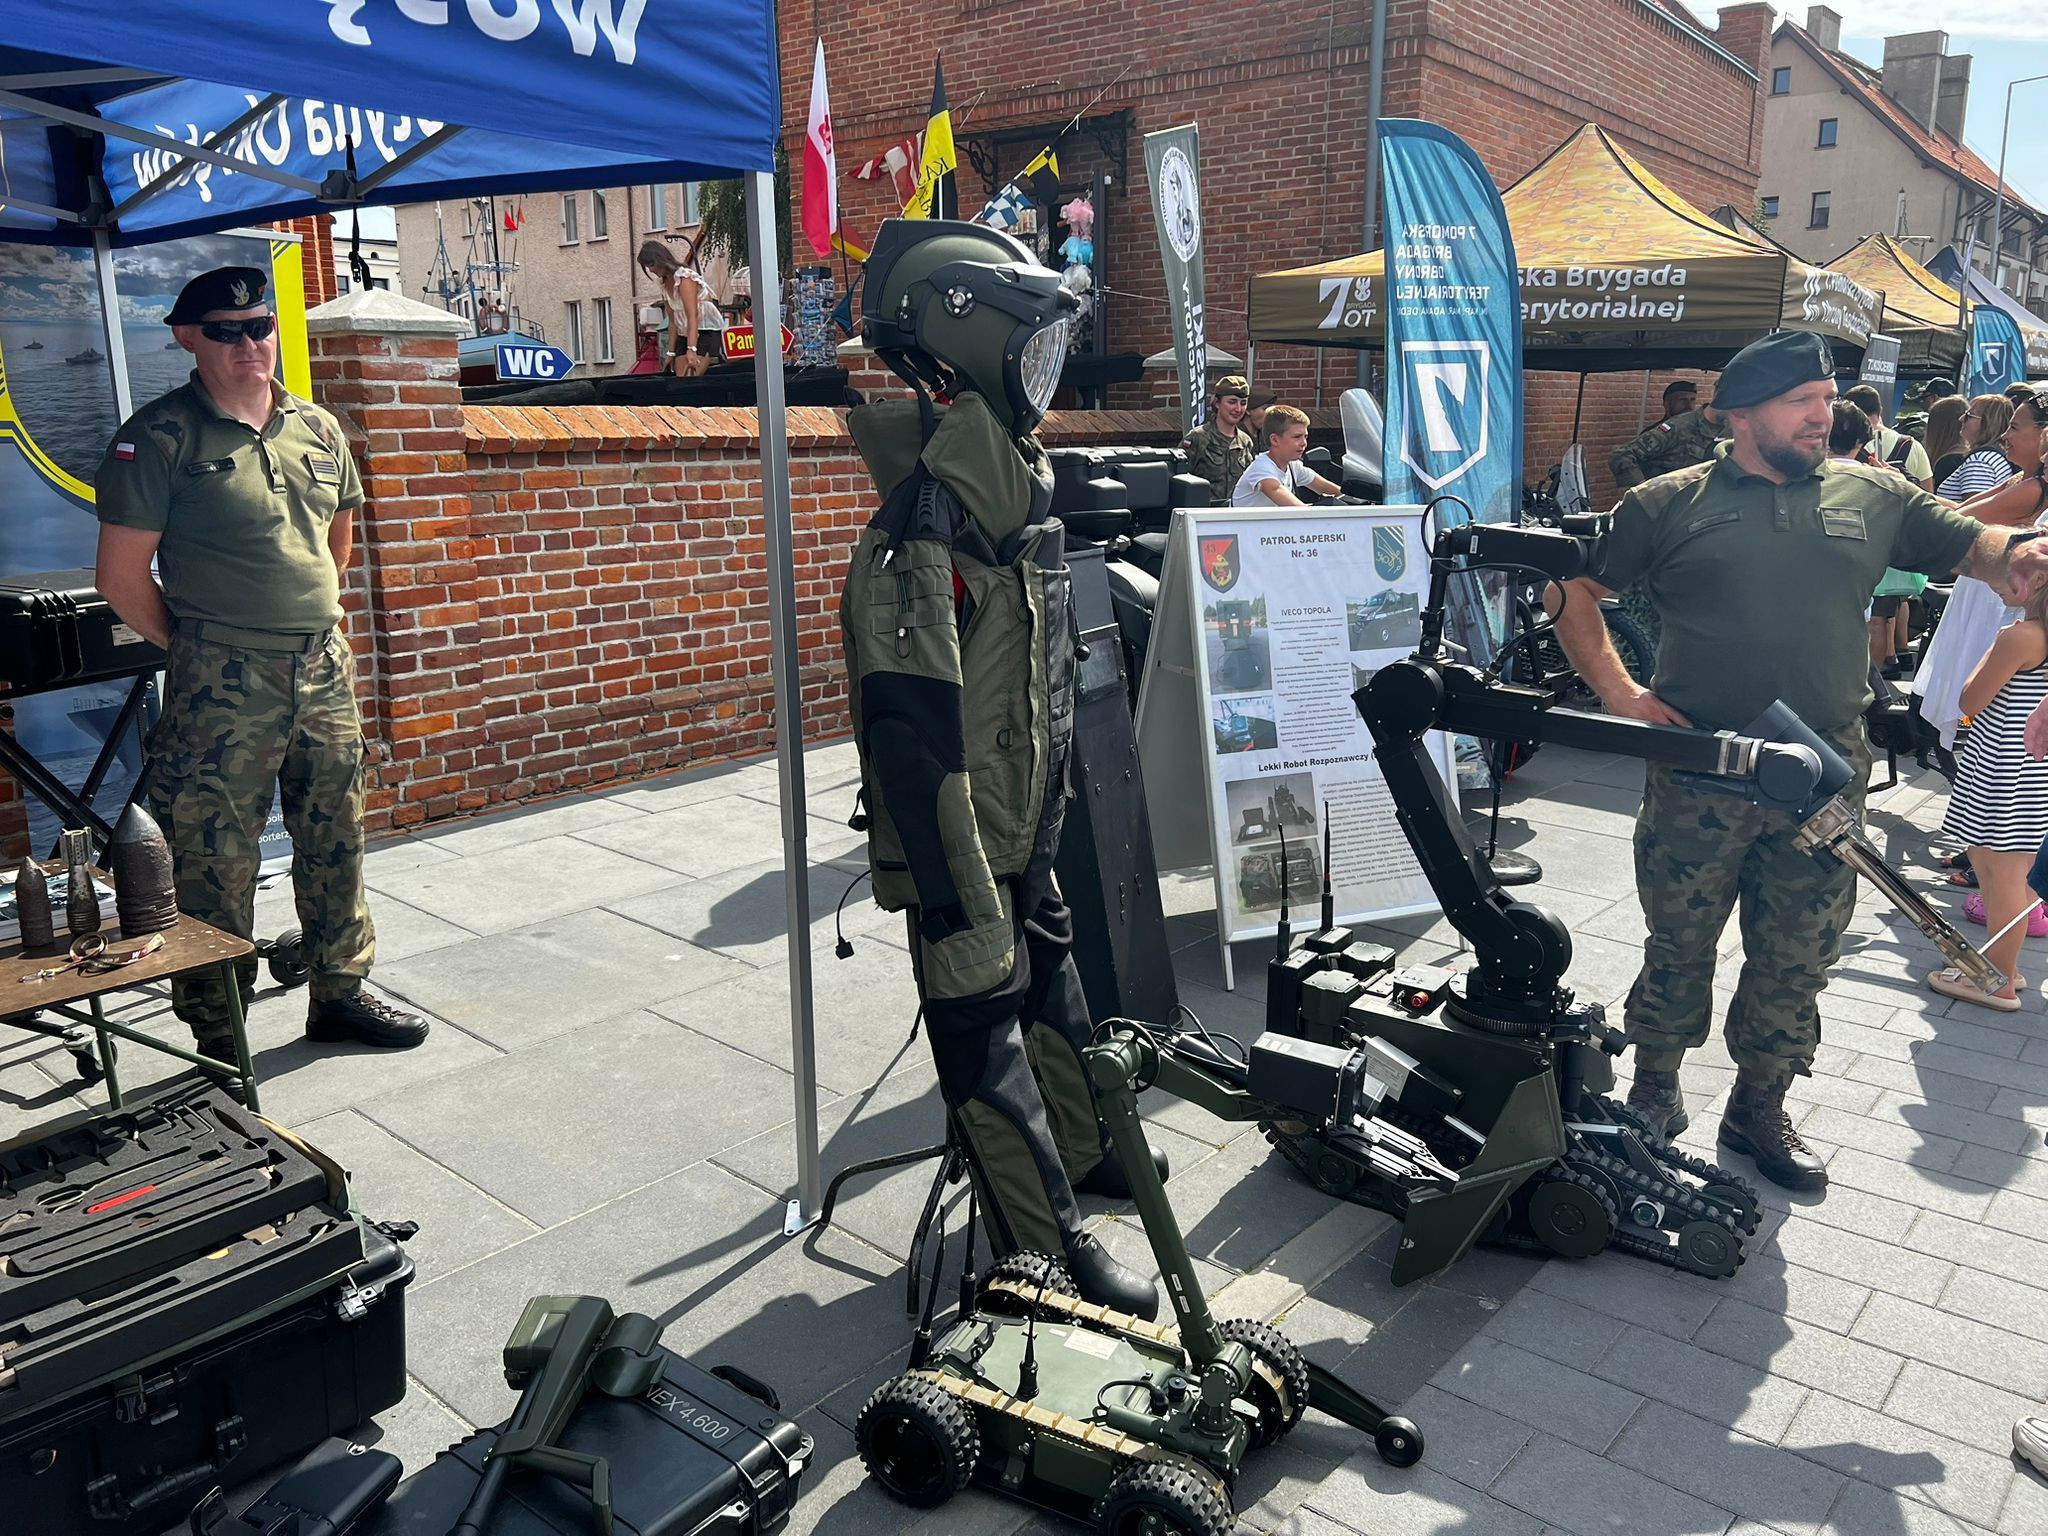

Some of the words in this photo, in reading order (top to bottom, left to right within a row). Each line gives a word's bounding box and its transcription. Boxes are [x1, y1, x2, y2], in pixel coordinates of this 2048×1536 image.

[1566, 264, 1687, 292] Brygada
[1344, 310, 1377, 328] OT
[503, 348, 555, 377] WC
[1260, 535, 1297, 546] PATROL
[1299, 533, 1346, 544] SAPERSKI
[1291, 549, 1304, 559] Nr.
[1306, 548, 1319, 558] 36
[1281, 608, 1302, 617] IVECO
[1303, 606, 1332, 615] TOPOLA
[1258, 761, 1281, 772] Lekki
[1283, 759, 1308, 770] Robot
[1310, 753, 1369, 767] Rozpoznawczy
[680, 1407, 730, 1439] 4.600
